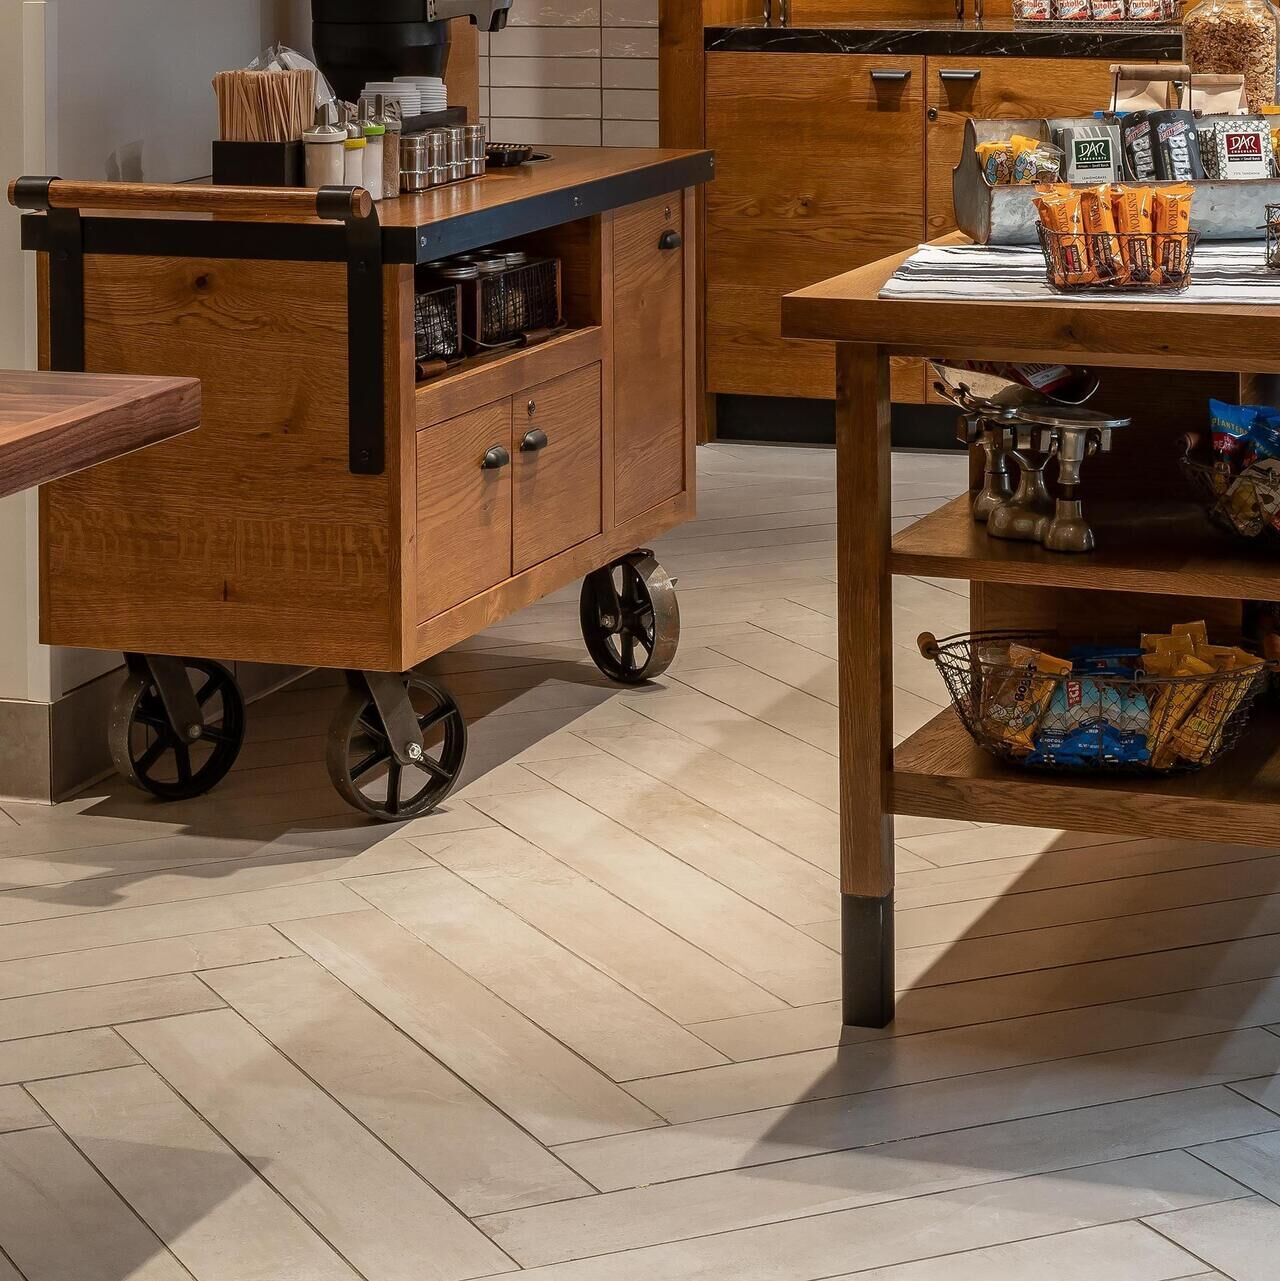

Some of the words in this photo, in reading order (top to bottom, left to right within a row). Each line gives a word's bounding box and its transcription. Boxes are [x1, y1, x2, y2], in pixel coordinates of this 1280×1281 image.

[1025, 0, 1043, 8] tella
[1132, 0, 1159, 9] nutella
[1230, 135, 1258, 150] DAR
[1078, 141, 1106, 157] DAR
